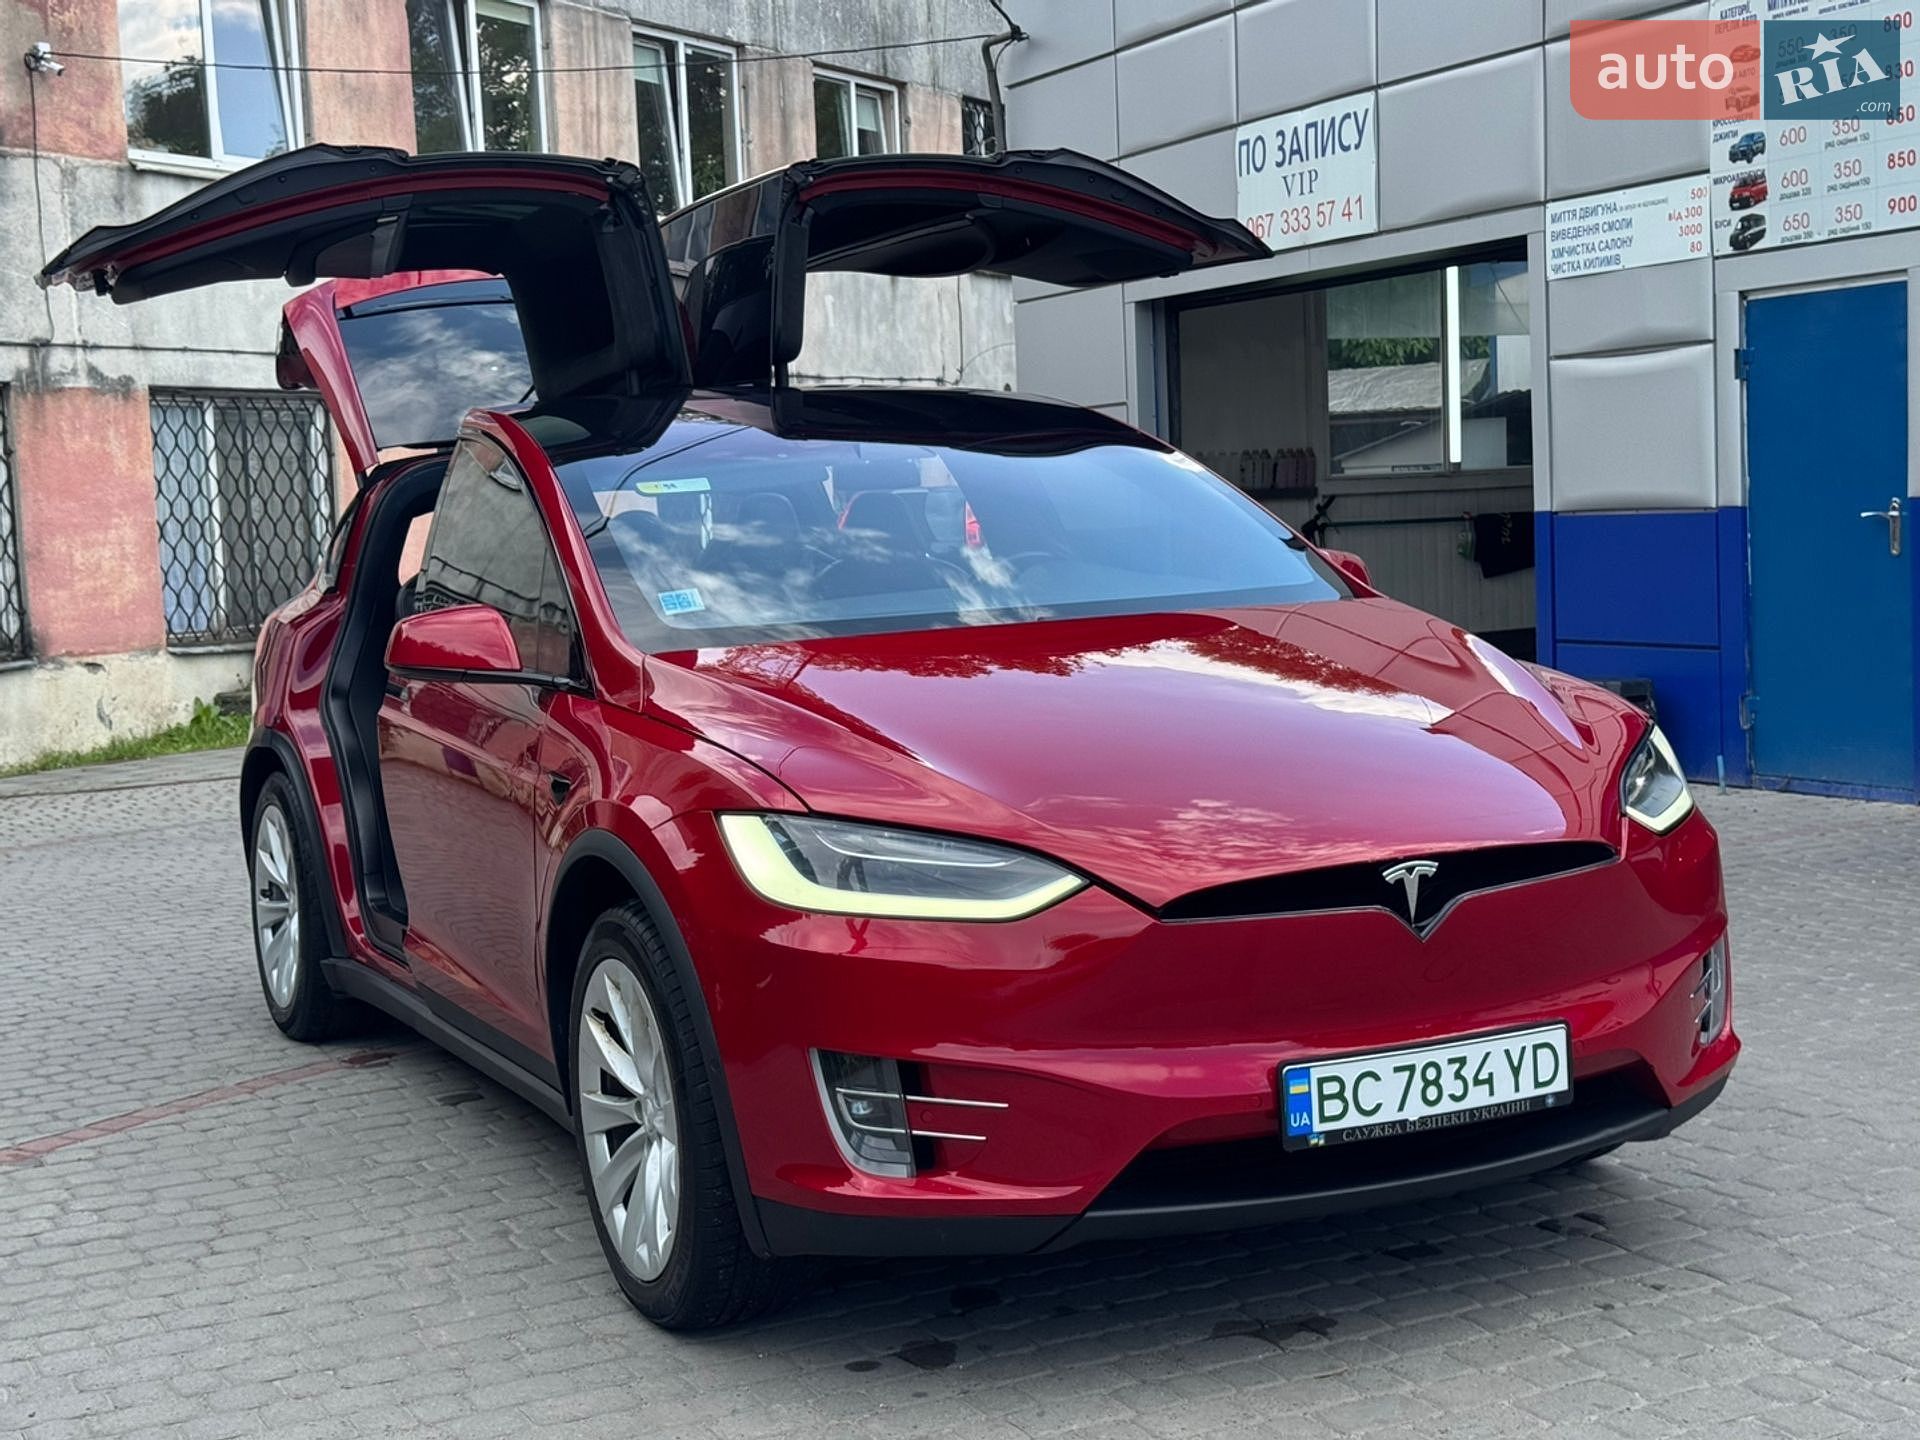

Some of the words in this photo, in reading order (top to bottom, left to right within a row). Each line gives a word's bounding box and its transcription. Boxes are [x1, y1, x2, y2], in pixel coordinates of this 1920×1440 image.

[1883, 11, 1912, 32] 800
[1780, 126, 1806, 146] 600
[1832, 115, 1860, 136] 350
[1239, 134, 1266, 177] ПО
[1275, 108, 1369, 168] ЗАПИСУ
[1834, 159, 1861, 179] 350
[1888, 149, 1916, 170] 850
[1282, 168, 1319, 198] VIP
[1782, 168, 1808, 189] 600
[1280, 205, 1311, 235] 333
[1317, 200, 1335, 228] 57
[1342, 194, 1363, 222] 41
[1551, 210, 1577, 224] МИТТЯ
[1579, 202, 1618, 220] ДВИГУНА
[1685, 205, 1703, 219] 300
[1834, 203, 1863, 223] 350
[1888, 195, 1917, 214] 900
[1551, 223, 1600, 242] ВИВЕДЕННЯ
[1602, 217, 1633, 233] СМОЛИ
[1678, 223, 1703, 237] 3000
[1783, 212, 1810, 232] 650
[1551, 242, 1599, 259] ХІМЧИСТКА
[1600, 236, 1633, 252] САЛОНУ
[1551, 261, 1581, 275] ЧИСТКА
[1583, 253, 1621, 270] КИЛИМІВ
[1316, 1070, 1383, 1123] BC
[1393, 1050, 1495, 1113] 7834
[1503, 1042, 1560, 1093] YD
[1290, 1111, 1311, 1127] UA
[1342, 1123, 1401, 1142] СЛУЖБА
[1406, 1112, 1470, 1133] БЕЗПЕКИ
